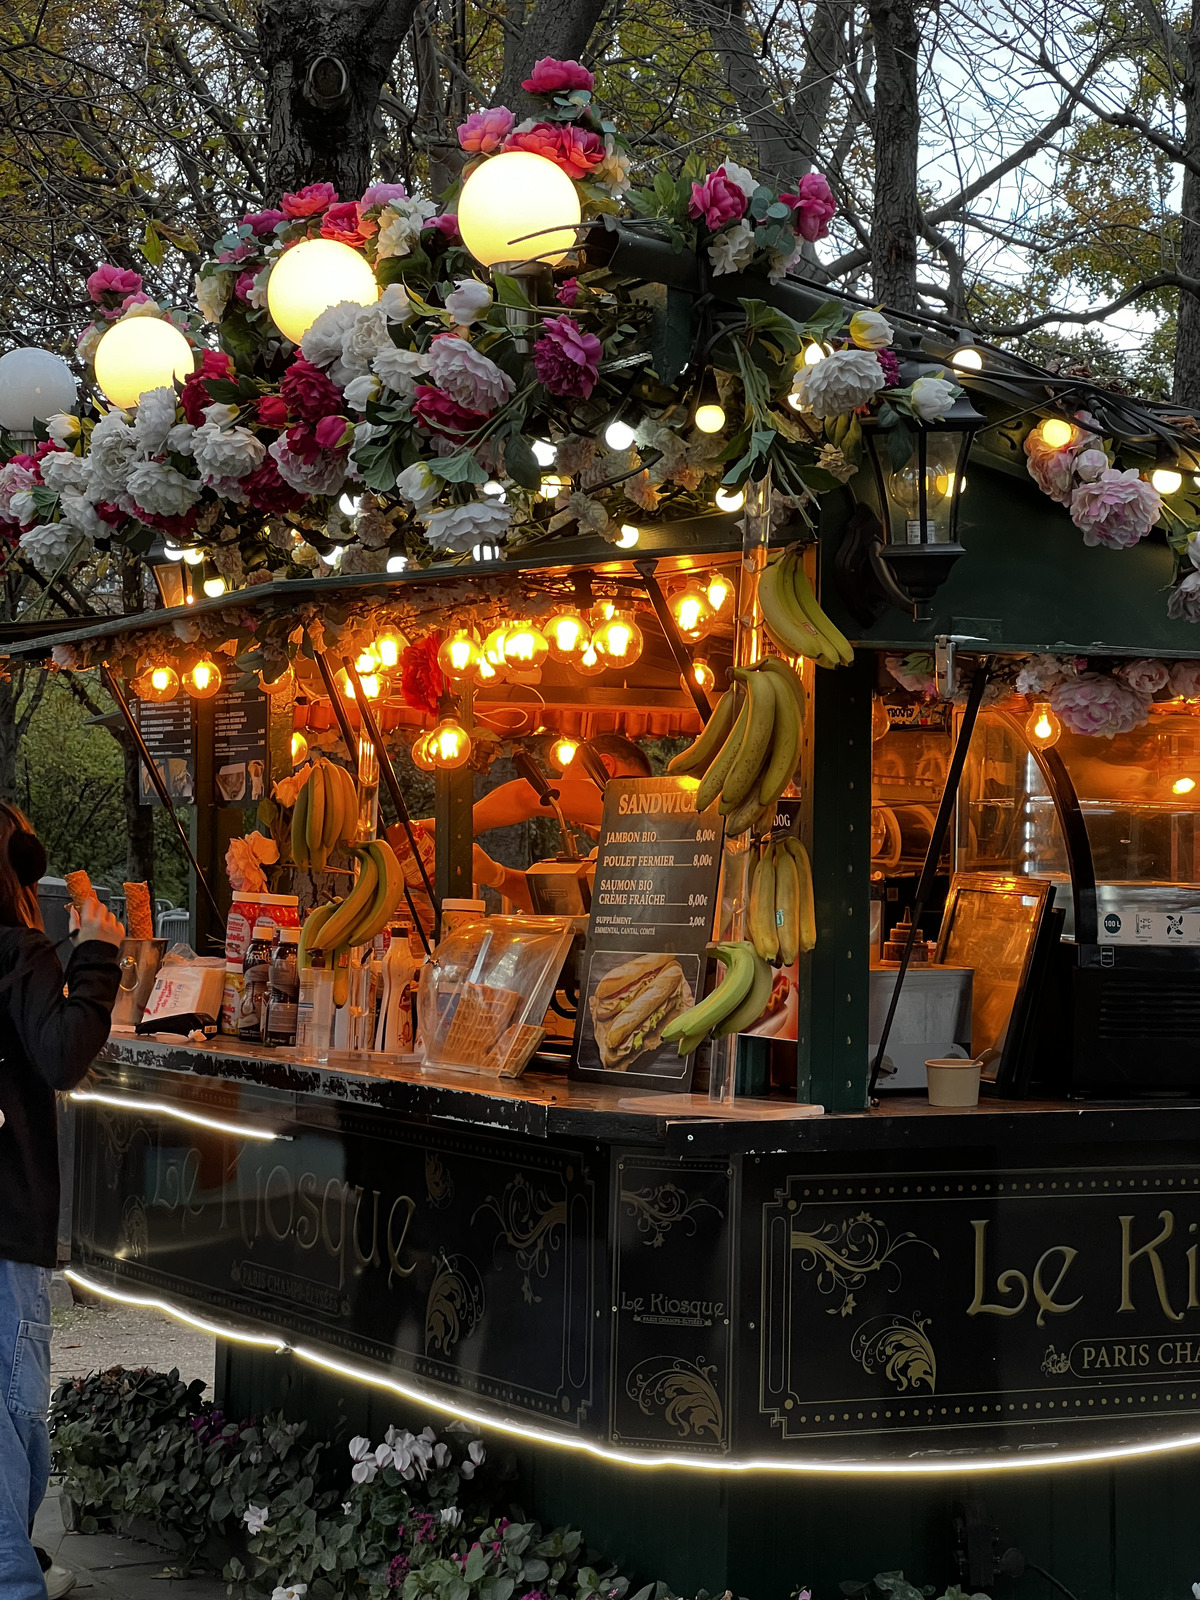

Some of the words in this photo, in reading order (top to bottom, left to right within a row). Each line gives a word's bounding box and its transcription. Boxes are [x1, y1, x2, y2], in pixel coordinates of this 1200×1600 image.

[773, 813, 791, 827] DOG
[605, 831, 639, 847] JAMBON
[641, 831, 657, 843] BIO
[695, 829, 716, 842] 8,00€
[603, 855, 637, 868] POULET
[638, 855, 675, 867] FERMIER
[692, 854, 713, 868] 8,00€
[600, 879, 637, 892] SAUMON
[638, 879, 653, 891] BIO
[599, 891, 627, 905] CRÈME
[628, 891, 666, 906] FRAÎCHE
[688, 894, 709, 908] 8,00€
[596, 914, 632, 925] SUPPLÉMENT
[1105, 920, 1116, 928] 100
[242, 1267, 266, 1289] PARIS
[965, 1218, 1085, 1328] Le
[620, 1291, 645, 1313] Le
[650, 1293, 726, 1319] Kiosque
[1082, 1343, 1150, 1369] PARIS
